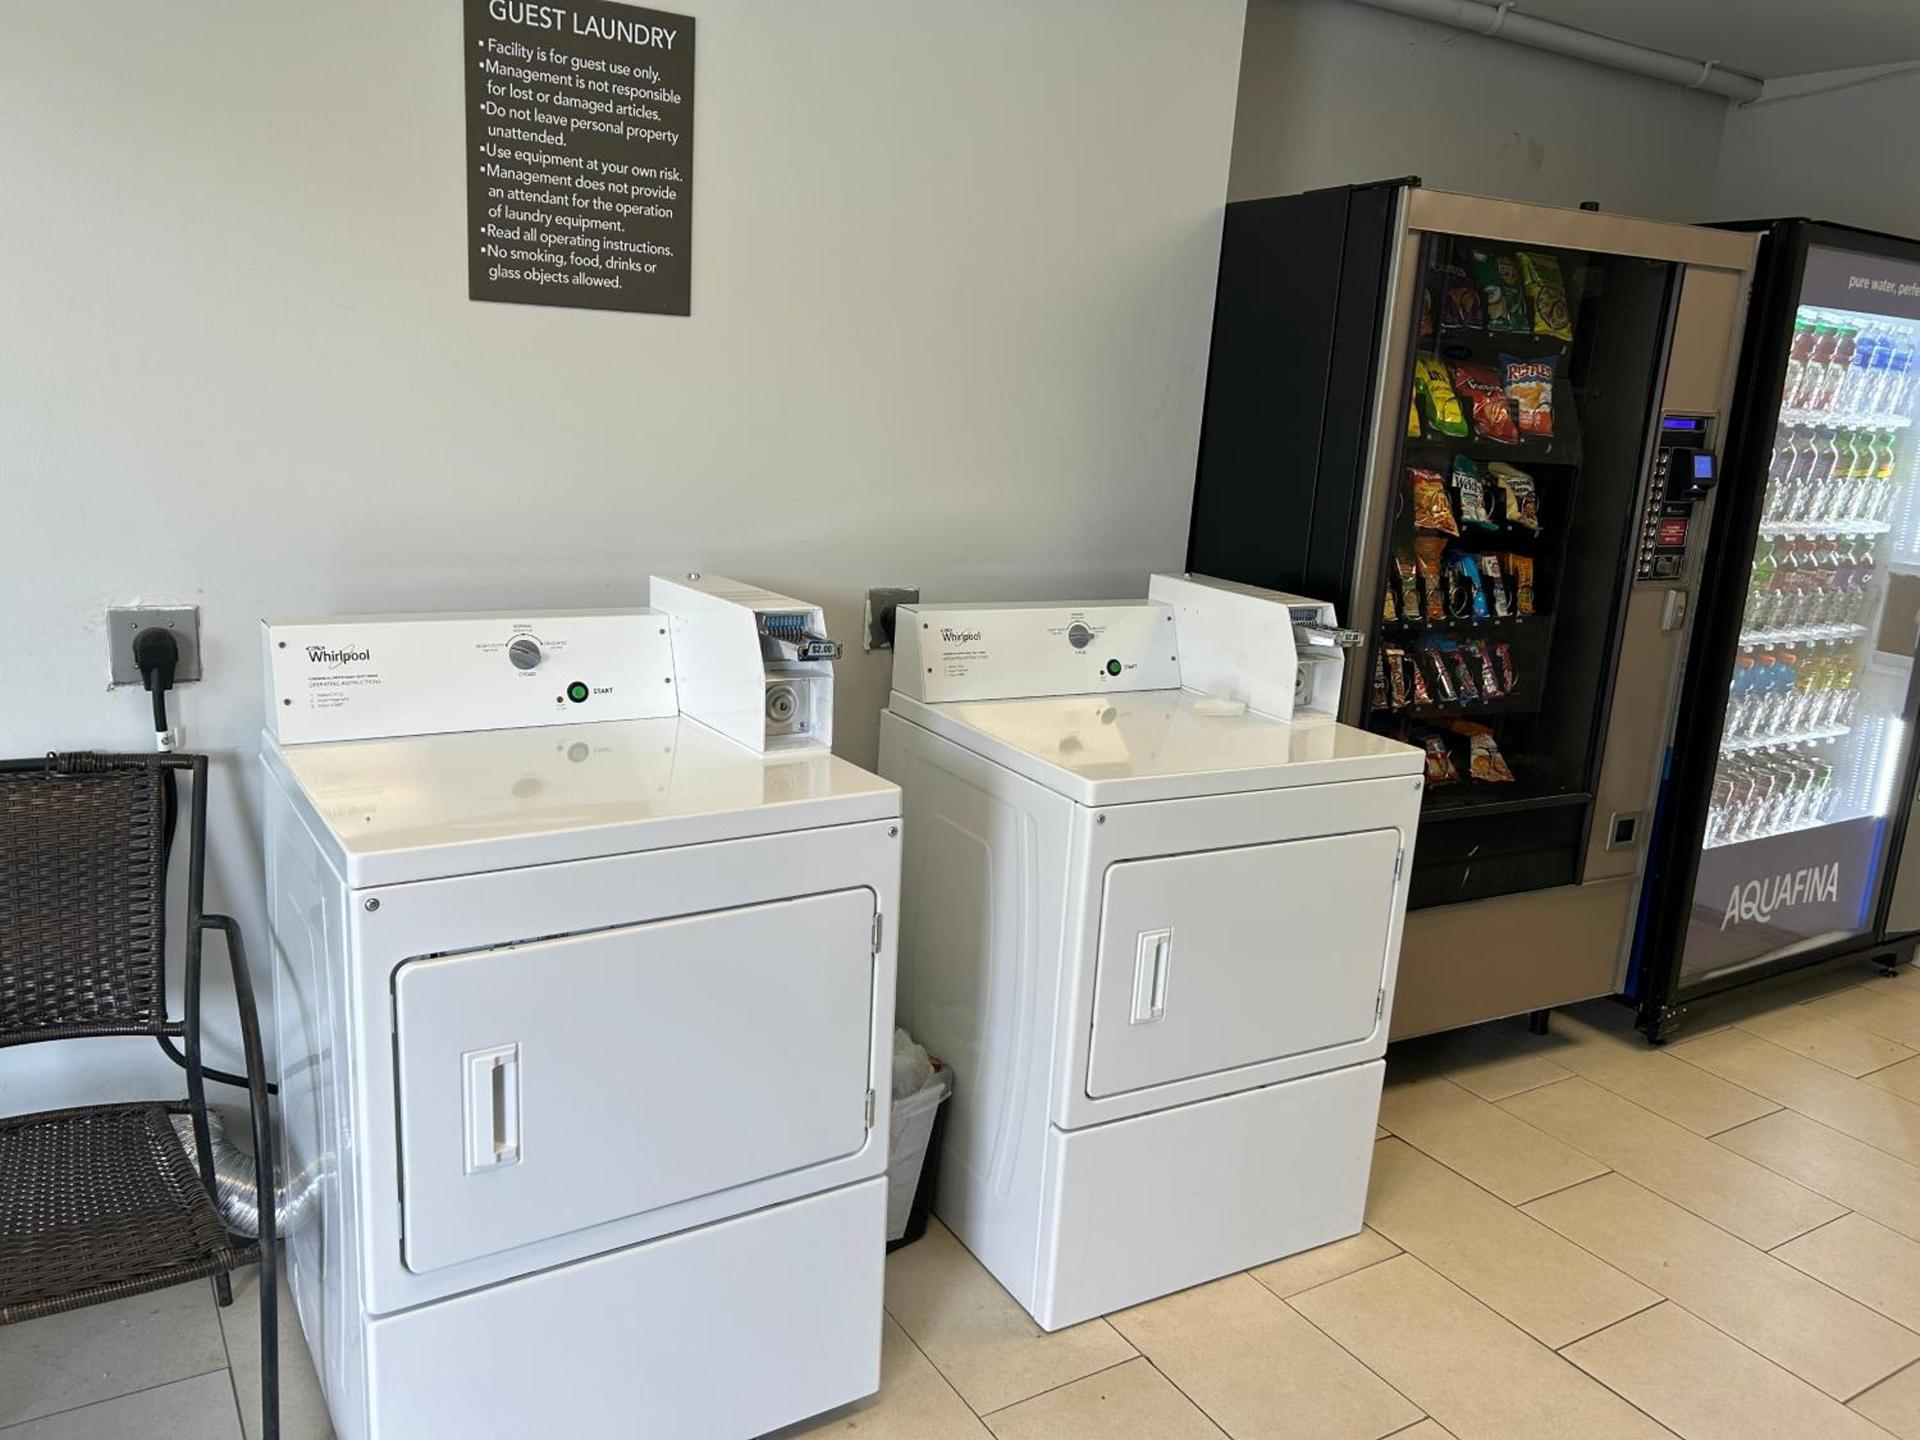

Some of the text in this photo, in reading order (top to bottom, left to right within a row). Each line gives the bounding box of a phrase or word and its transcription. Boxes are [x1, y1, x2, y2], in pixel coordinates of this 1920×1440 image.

[489, 0, 677, 50] GUEST LAUNDRY
[488, 38, 661, 83] Facility is for guest use only.
[486, 59, 682, 104] Management is not responsible
[487, 80, 662, 122] for lost or damaged articles.
[486, 101, 679, 146] Do not leave personal property
[488, 125, 567, 146] unattended.
[486, 143, 684, 182] Use equipment at your own risk.
[486, 163, 677, 200] Management does not provide
[488, 187, 673, 218] an attendant for the operation
[488, 203, 625, 232] of laundry equipment.
[487, 224, 674, 257] Read all operating instructions.
[487, 244, 657, 273] No smoking, food, drinks or
[489, 265, 623, 289] glass objects allowed.
[1848, 276, 1870, 290] pure
[1871, 280, 1896, 294] water,
[308, 649, 370, 664] Whirlpool
[812, 645, 832, 654] $2.00
[593, 687, 613, 695] START
[1720, 862, 1839, 931] AQUAFINA
